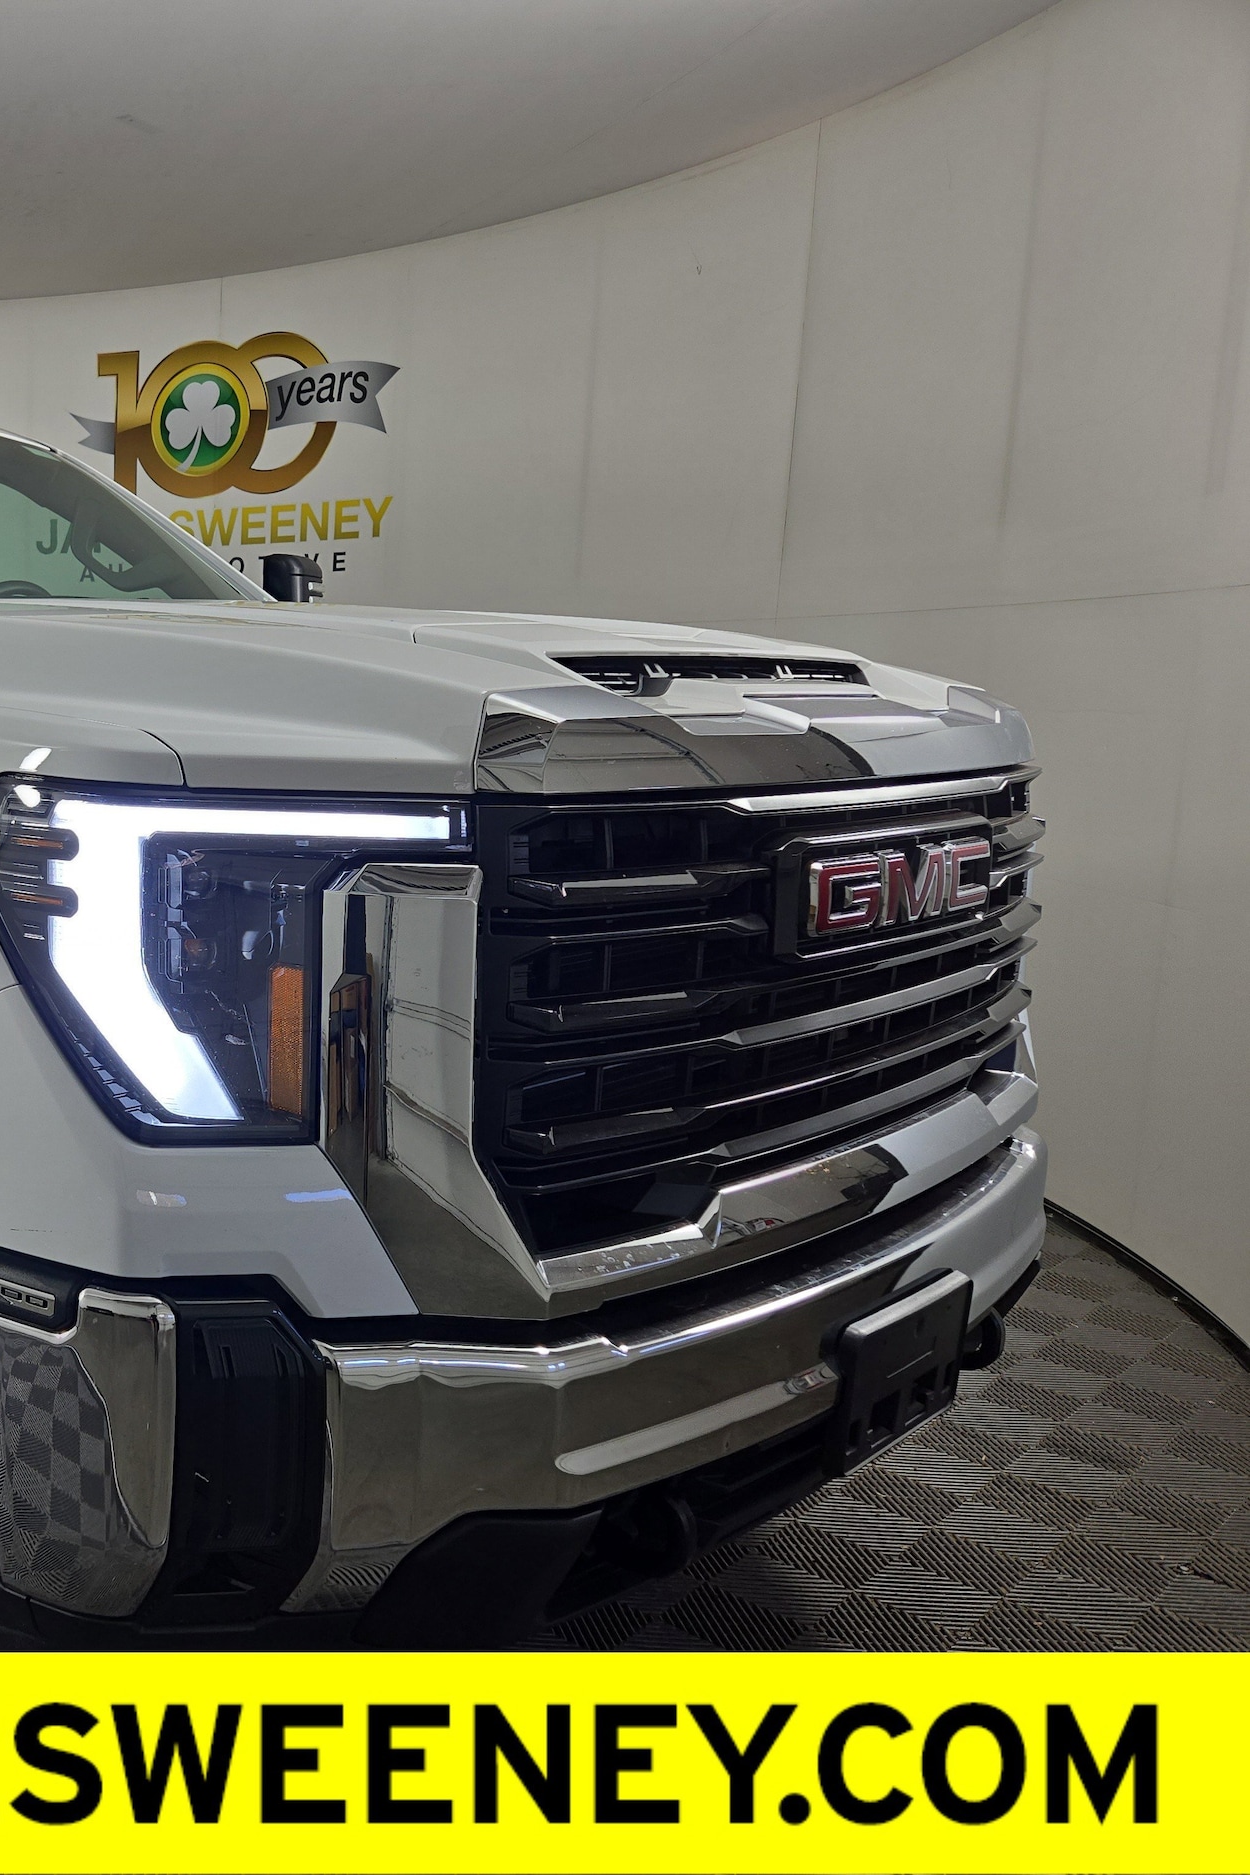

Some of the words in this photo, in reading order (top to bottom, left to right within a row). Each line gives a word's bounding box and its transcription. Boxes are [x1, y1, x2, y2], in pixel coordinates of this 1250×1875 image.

[97, 331, 337, 498] 100
[274, 369, 370, 421] years
[807, 836, 991, 938] GMC
